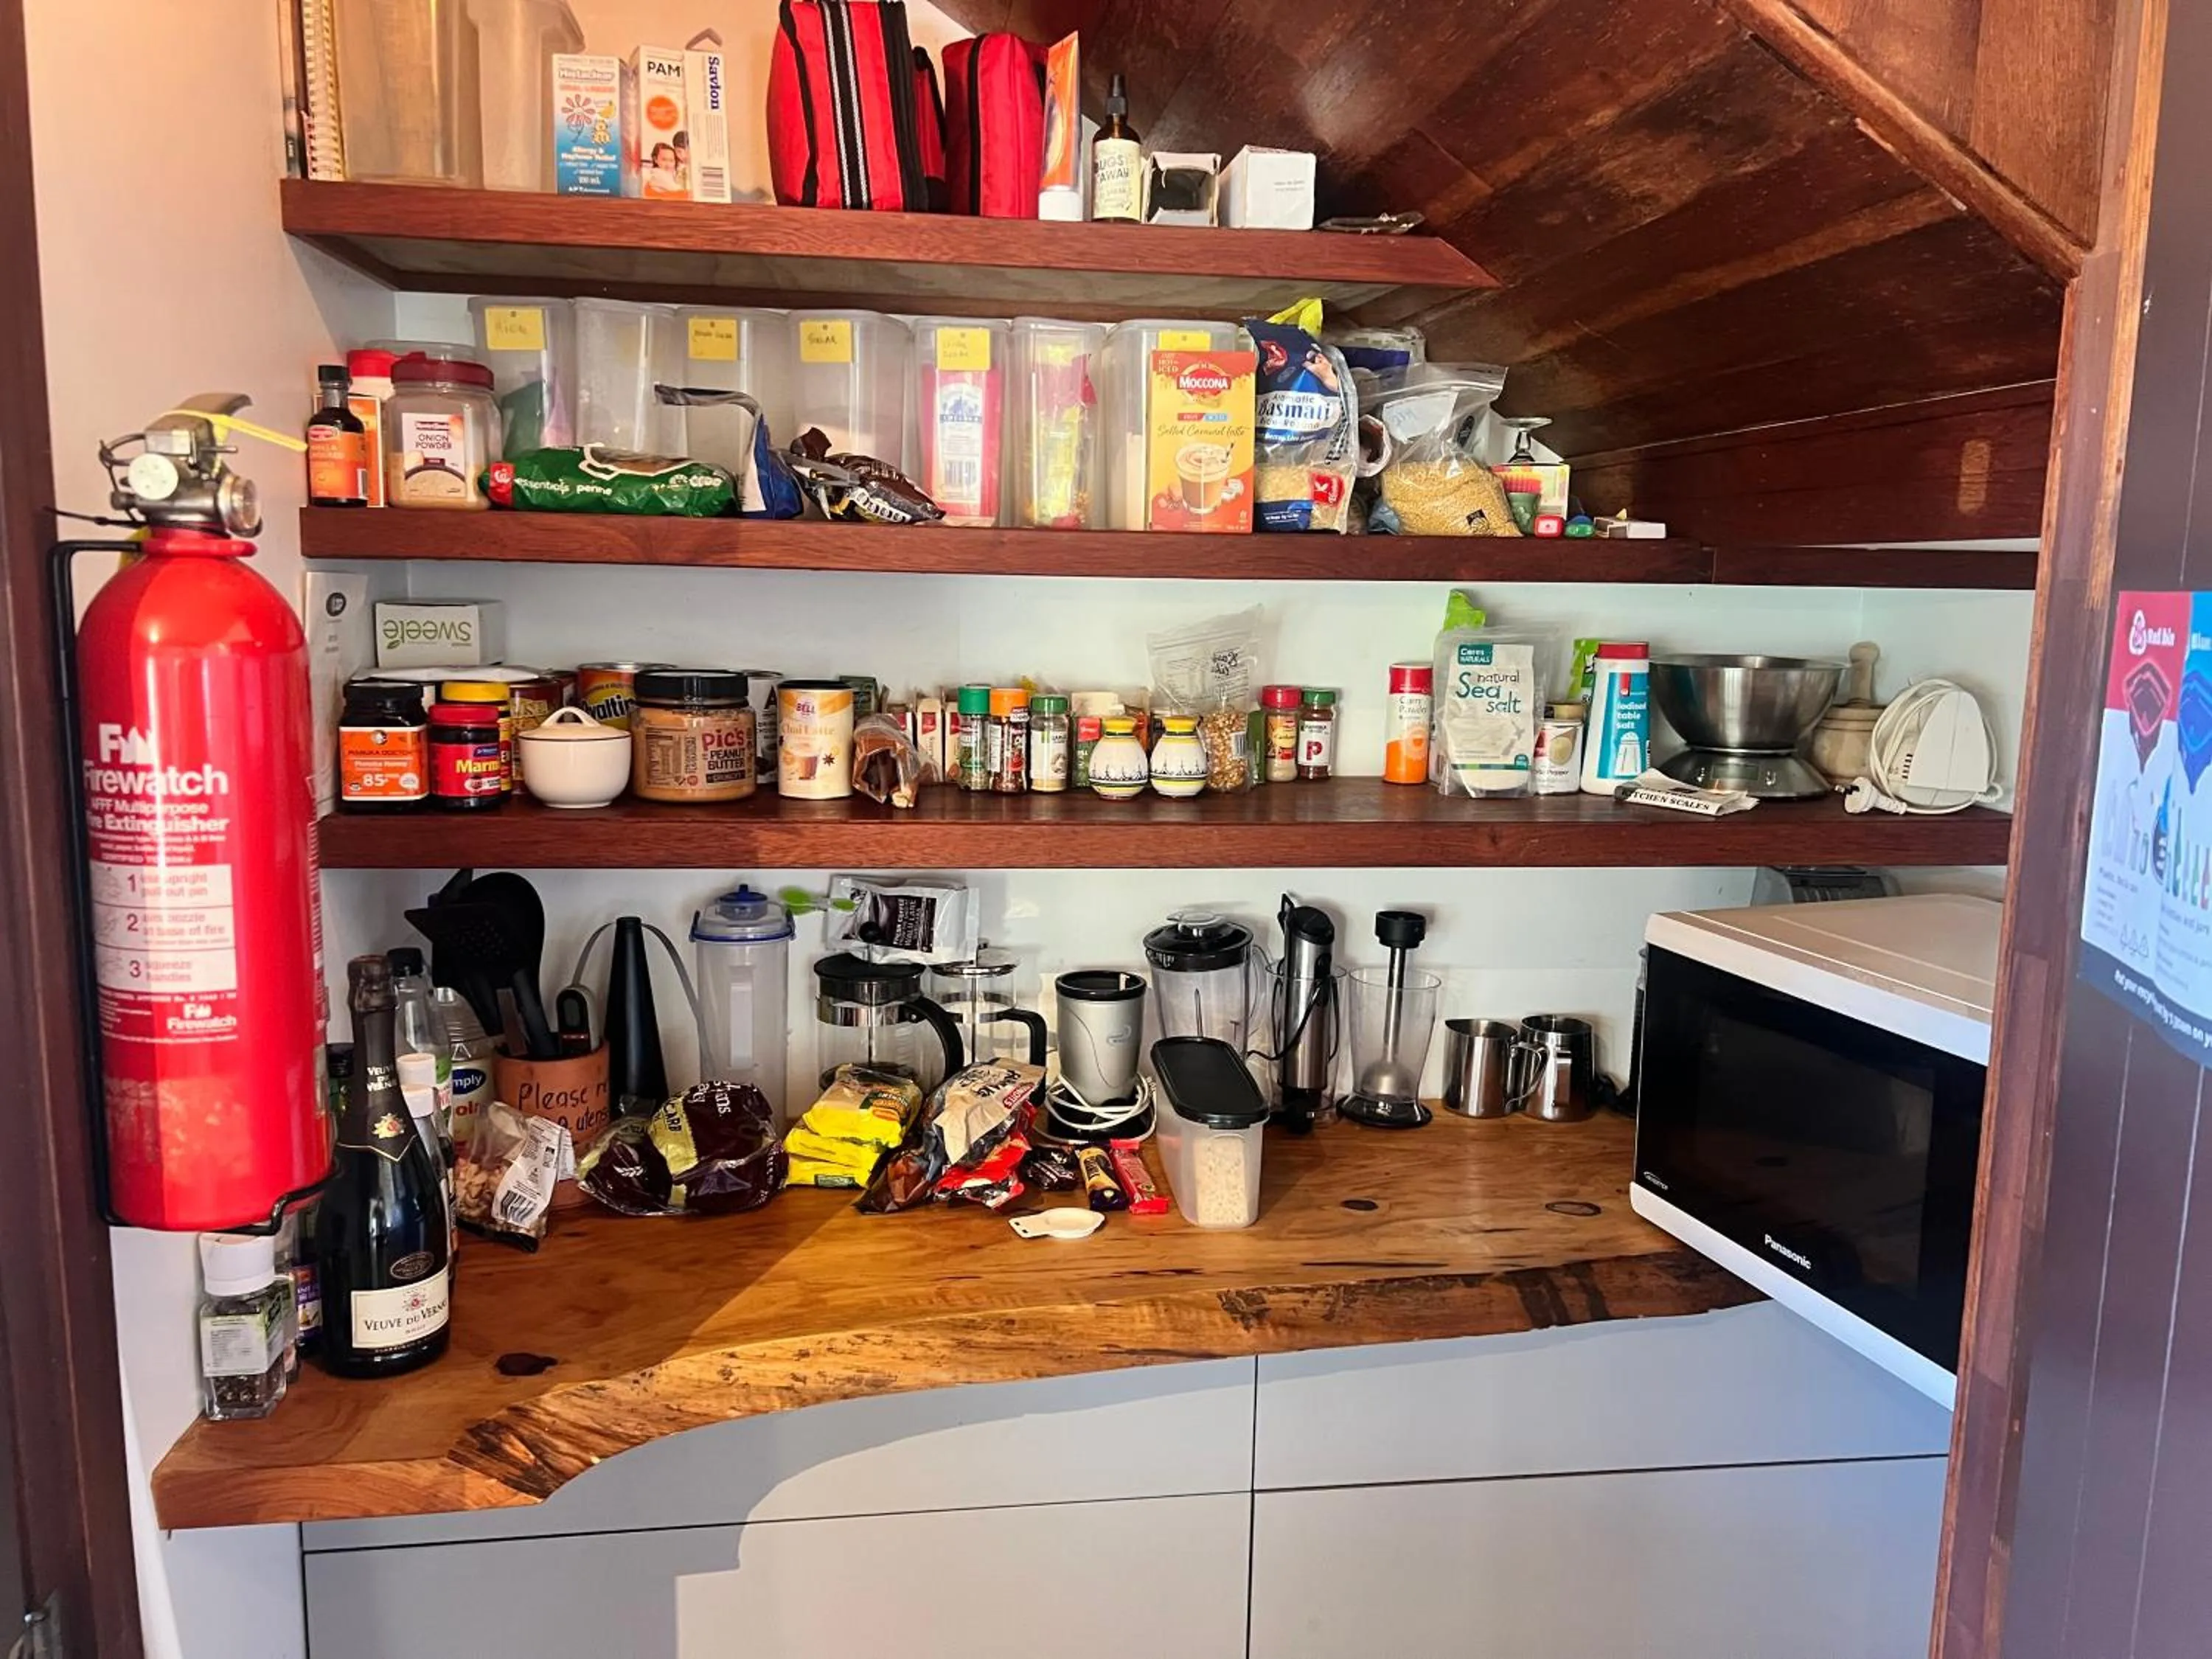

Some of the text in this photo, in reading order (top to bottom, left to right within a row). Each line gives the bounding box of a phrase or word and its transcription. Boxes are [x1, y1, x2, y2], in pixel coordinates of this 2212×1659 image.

[647, 60, 682, 77] PAM
[708, 56, 722, 111] Savlon
[1179, 376, 1229, 390] MOCCONA
[415, 442, 452, 450] POWDER
[418, 434, 449, 442] ONION
[577, 484, 613, 496] penne
[1455, 671, 1502, 699] Sea
[1477, 670, 1520, 684] natural
[1486, 691, 1521, 714] salt
[1615, 720, 1635, 729] salt
[710, 748, 745, 759] PEANUT
[456, 759, 501, 773] Marm
[708, 759, 745, 771] BUTTER
[83, 759, 229, 796] Firewatch
[1669, 796, 1711, 812] SCALES
[128, 874, 136, 892] 1
[127, 914, 139, 932] 2
[129, 960, 142, 978] 3
[518, 1082, 590, 1111] Please
[1764, 1233, 1812, 1270] Panasonic
[364, 1317, 403, 1332] VEUVE
